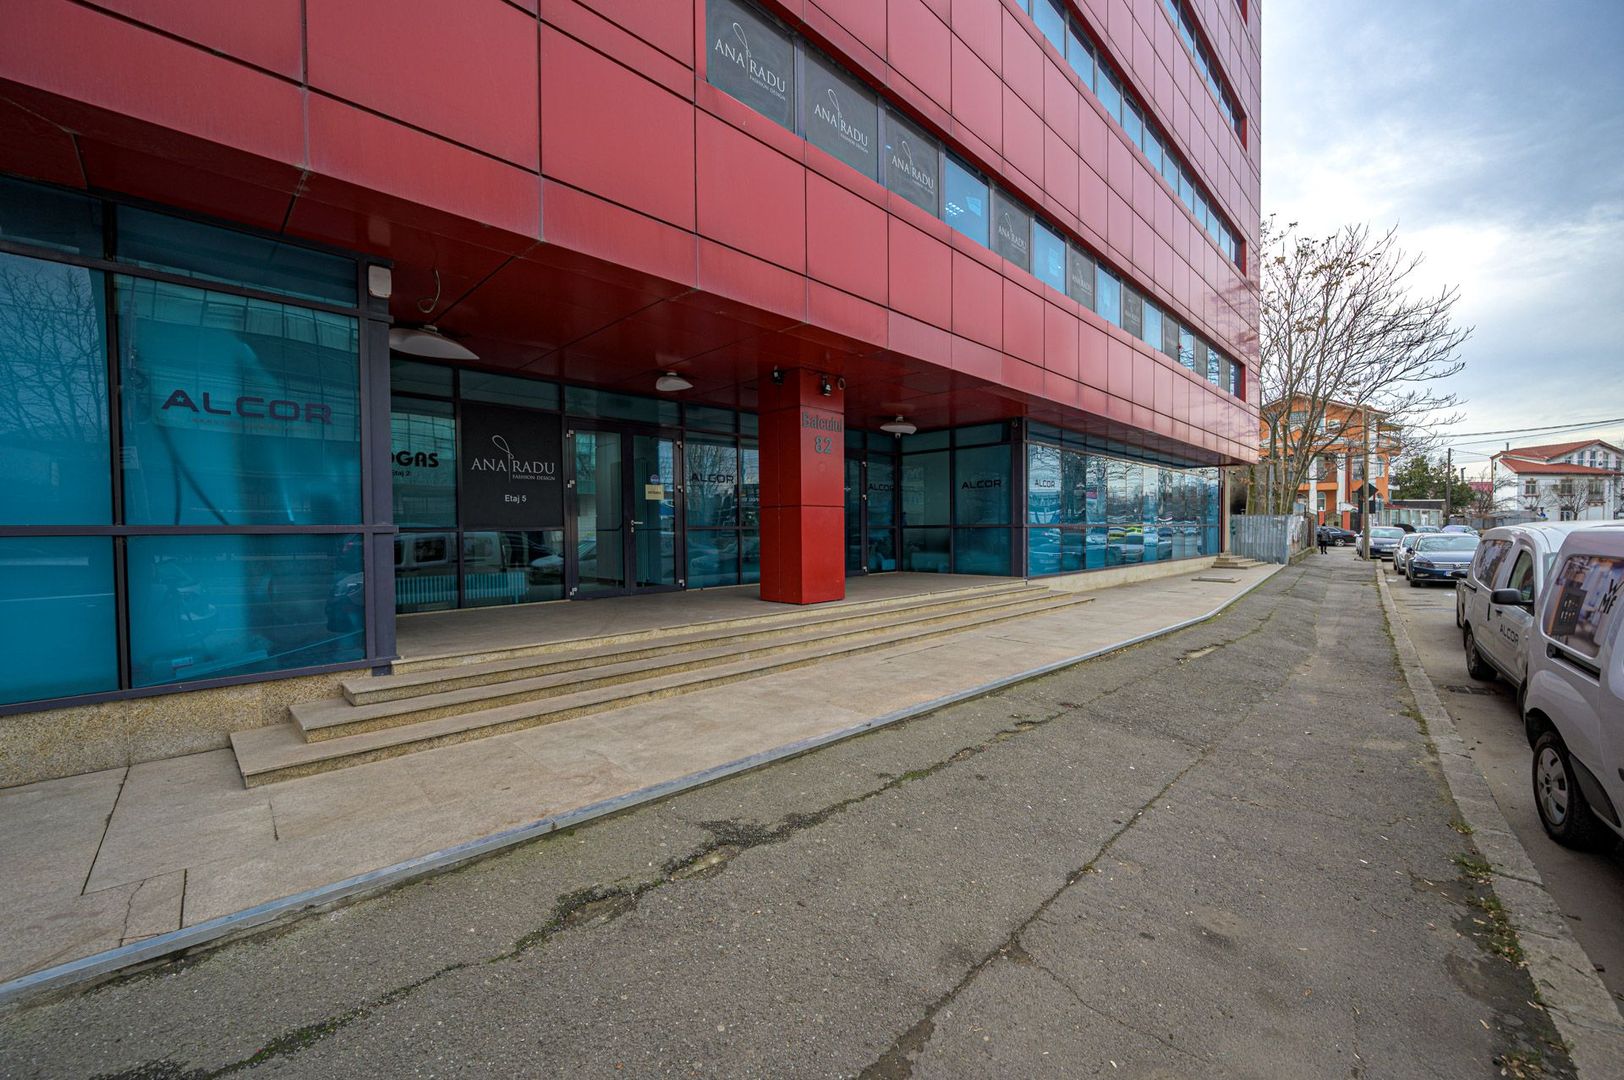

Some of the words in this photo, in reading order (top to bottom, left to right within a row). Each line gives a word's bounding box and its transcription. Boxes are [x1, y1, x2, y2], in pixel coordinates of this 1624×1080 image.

[715, 38, 745, 69] ANA
[750, 59, 786, 93] RADU
[815, 104, 838, 128] ANA
[841, 119, 868, 147] RADU
[891, 155, 910, 174] ANA
[912, 166, 934, 189] RADU
[161, 389, 332, 425] ALCOR
[815, 435, 832, 455] 82
[471, 458, 507, 472] ANA
[512, 460, 555, 475] RADU
[691, 473, 734, 484] ALCOR
[961, 479, 1001, 490] ALCOR
[1034, 479, 1055, 488] ALCOR
[504, 494, 520, 504] Etaj
